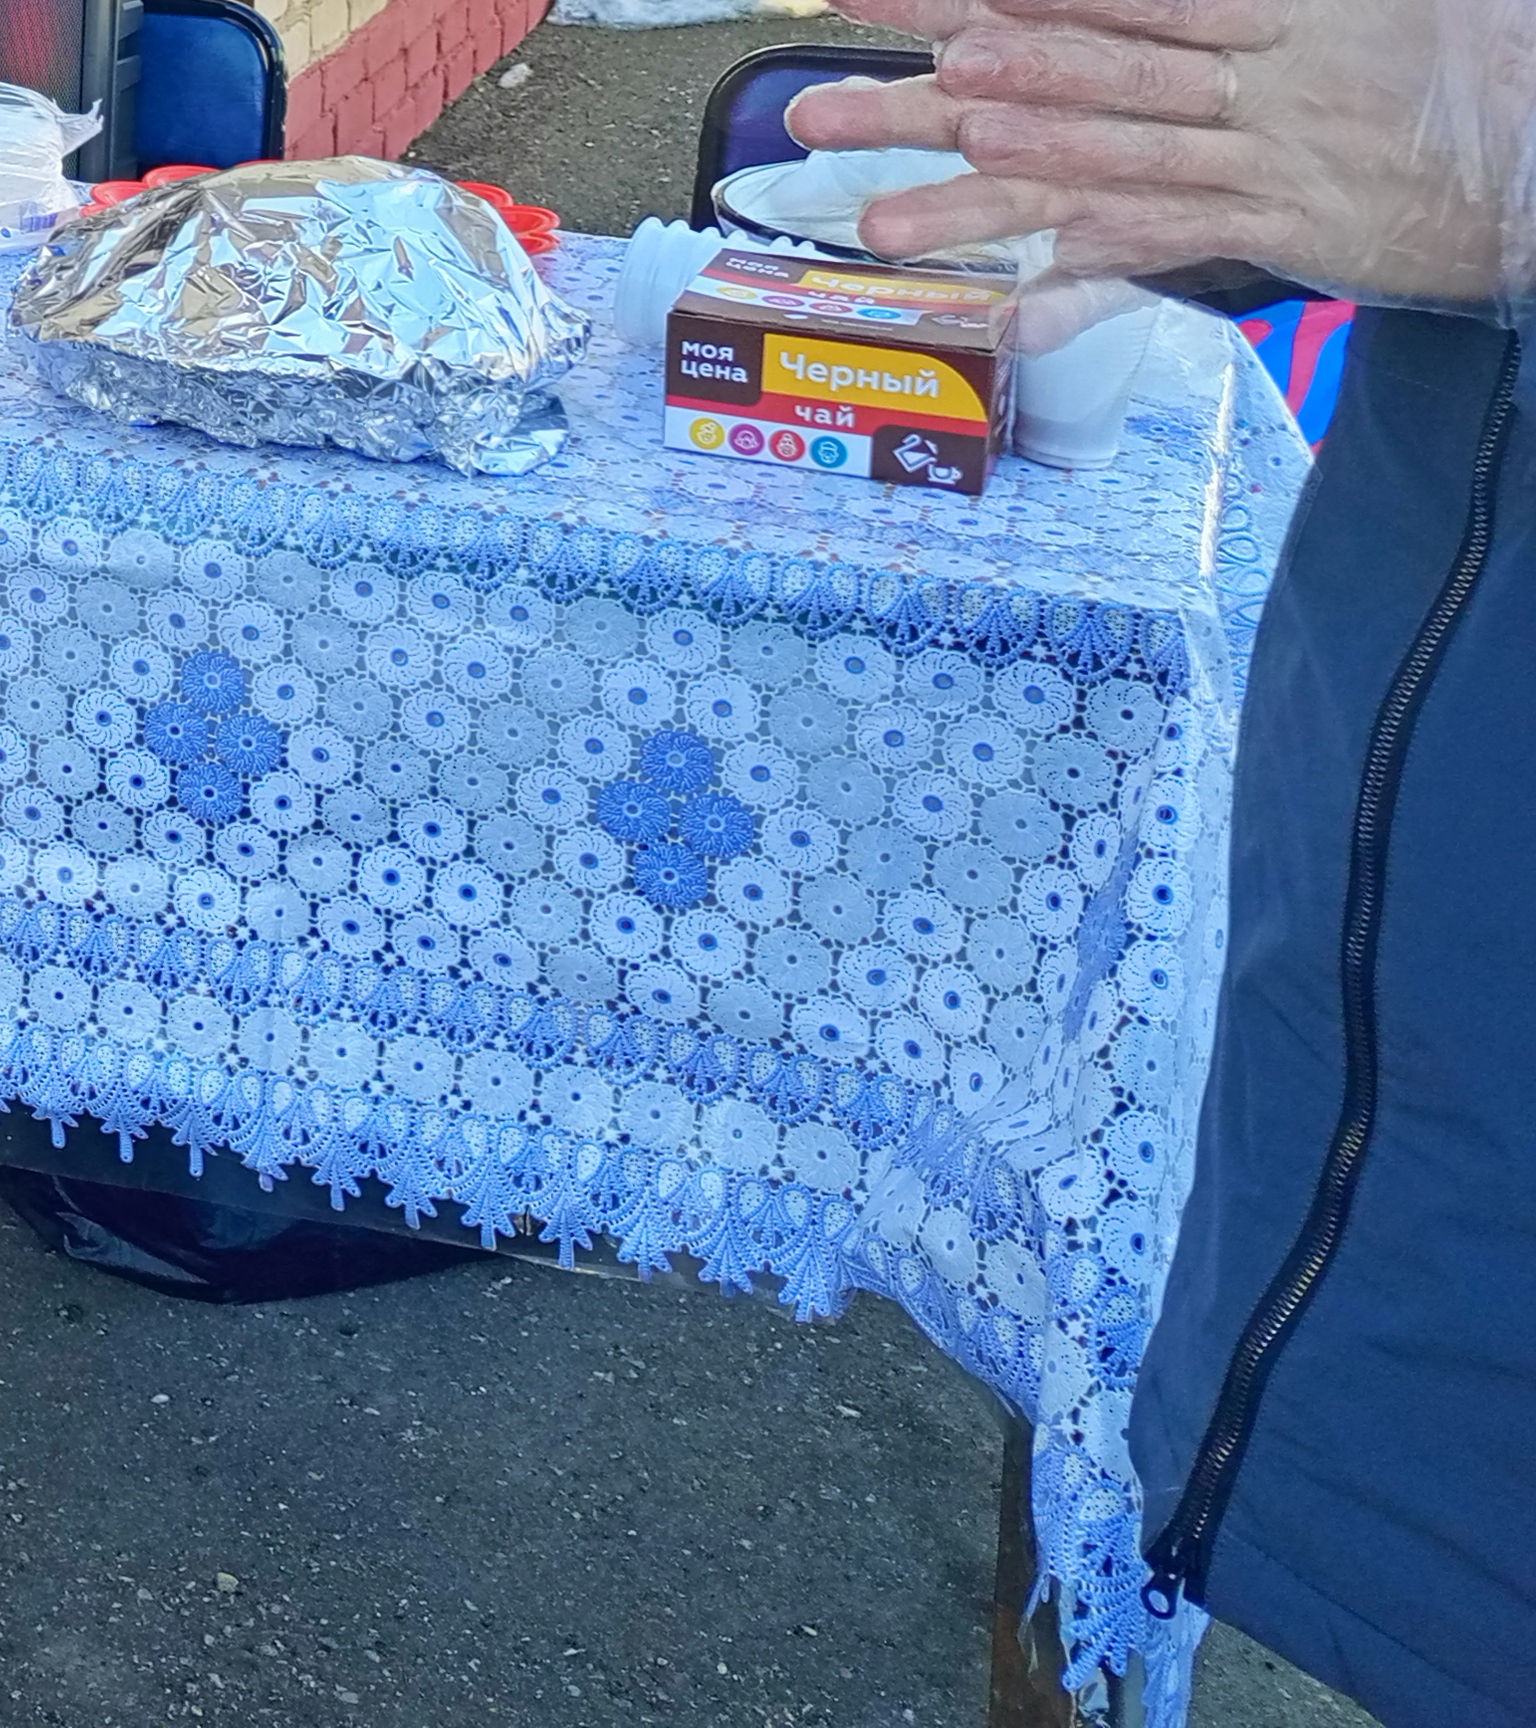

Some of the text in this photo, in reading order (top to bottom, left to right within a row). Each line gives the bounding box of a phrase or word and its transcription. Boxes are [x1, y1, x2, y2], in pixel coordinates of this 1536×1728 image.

[727, 262, 790, 279] цена
[728, 257, 779, 271] моя
[807, 290, 876, 305] чай
[811, 274, 991, 302] Черный
[681, 360, 749, 384] цена
[780, 350, 940, 399] Черный
[794, 404, 856, 429] чай
